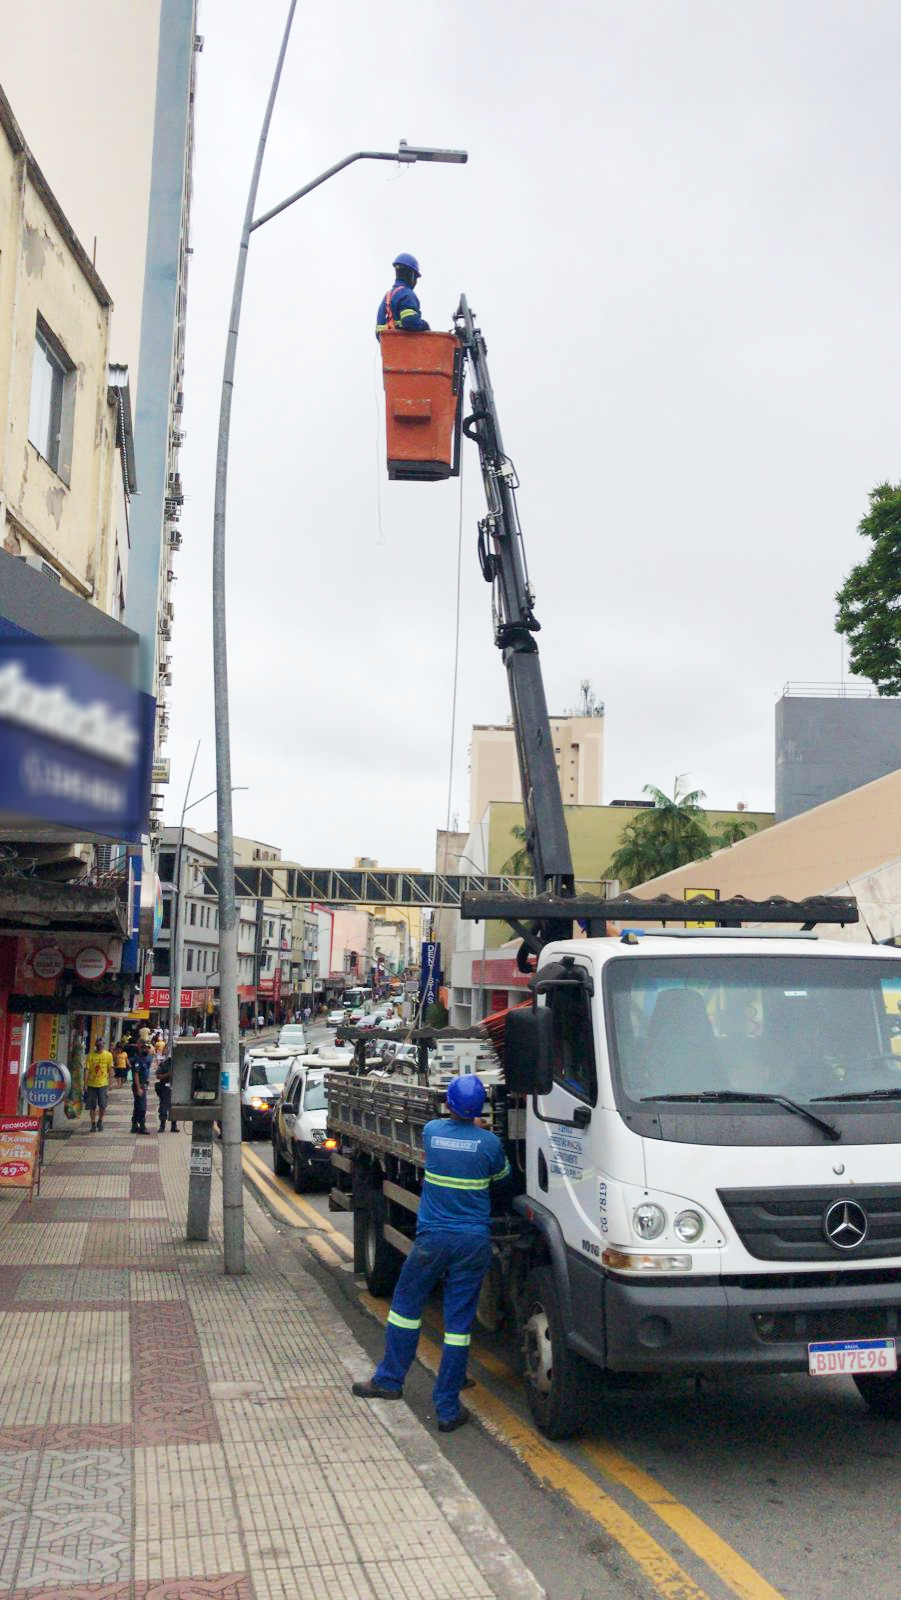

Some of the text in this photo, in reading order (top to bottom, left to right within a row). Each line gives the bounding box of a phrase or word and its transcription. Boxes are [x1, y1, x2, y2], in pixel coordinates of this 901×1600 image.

[34, 1078, 46, 1089] in
[29, 1091, 56, 1102] time
[1, 1120, 38, 1130] PROMOÇÃO
[1, 1135, 33, 1143] Exame
[434, 1139, 472, 1149] ENGELUZ
[2, 1149, 32, 1158] Vista
[599, 1182, 607, 1212] 7819
[817, 1350, 887, 1371] BDV7E96
